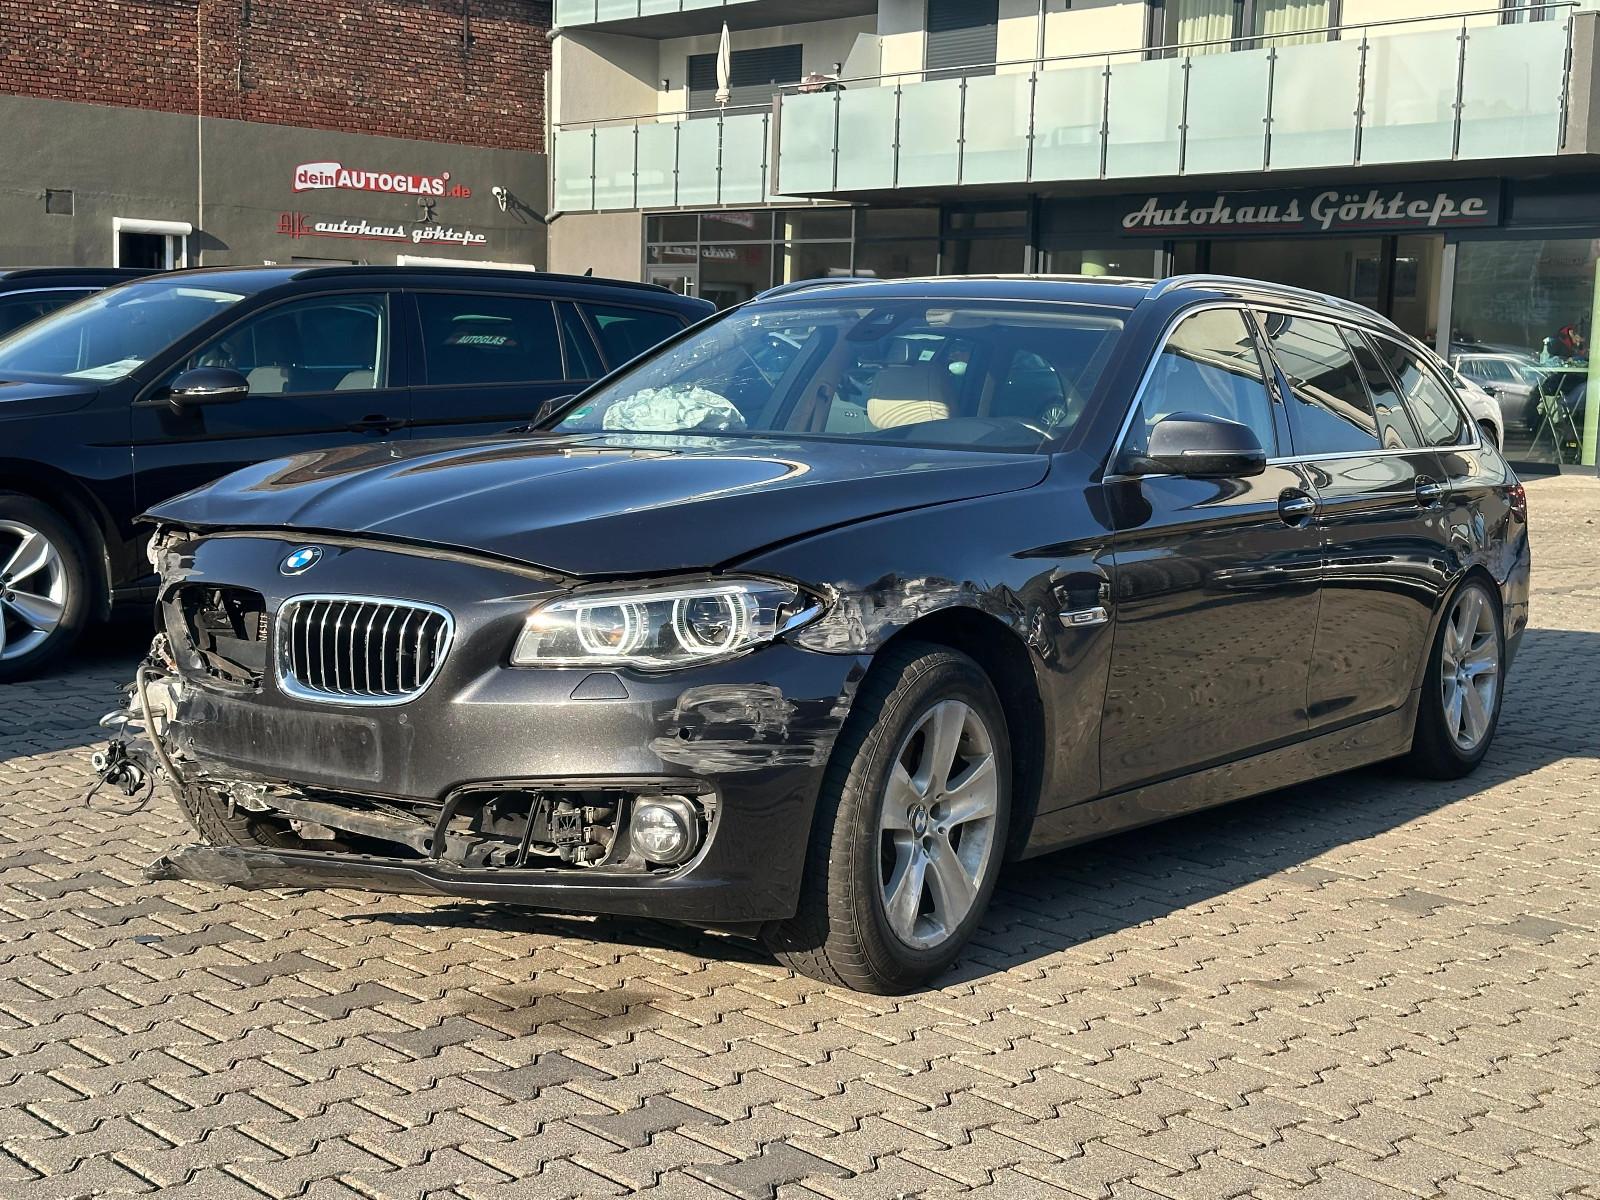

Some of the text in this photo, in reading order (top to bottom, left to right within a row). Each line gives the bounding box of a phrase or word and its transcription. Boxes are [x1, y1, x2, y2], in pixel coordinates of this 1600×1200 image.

[1122, 189, 1489, 230] Autohaus Göktepe
[315, 220, 407, 237] autohaus
[412, 225, 486, 245] göktepe
